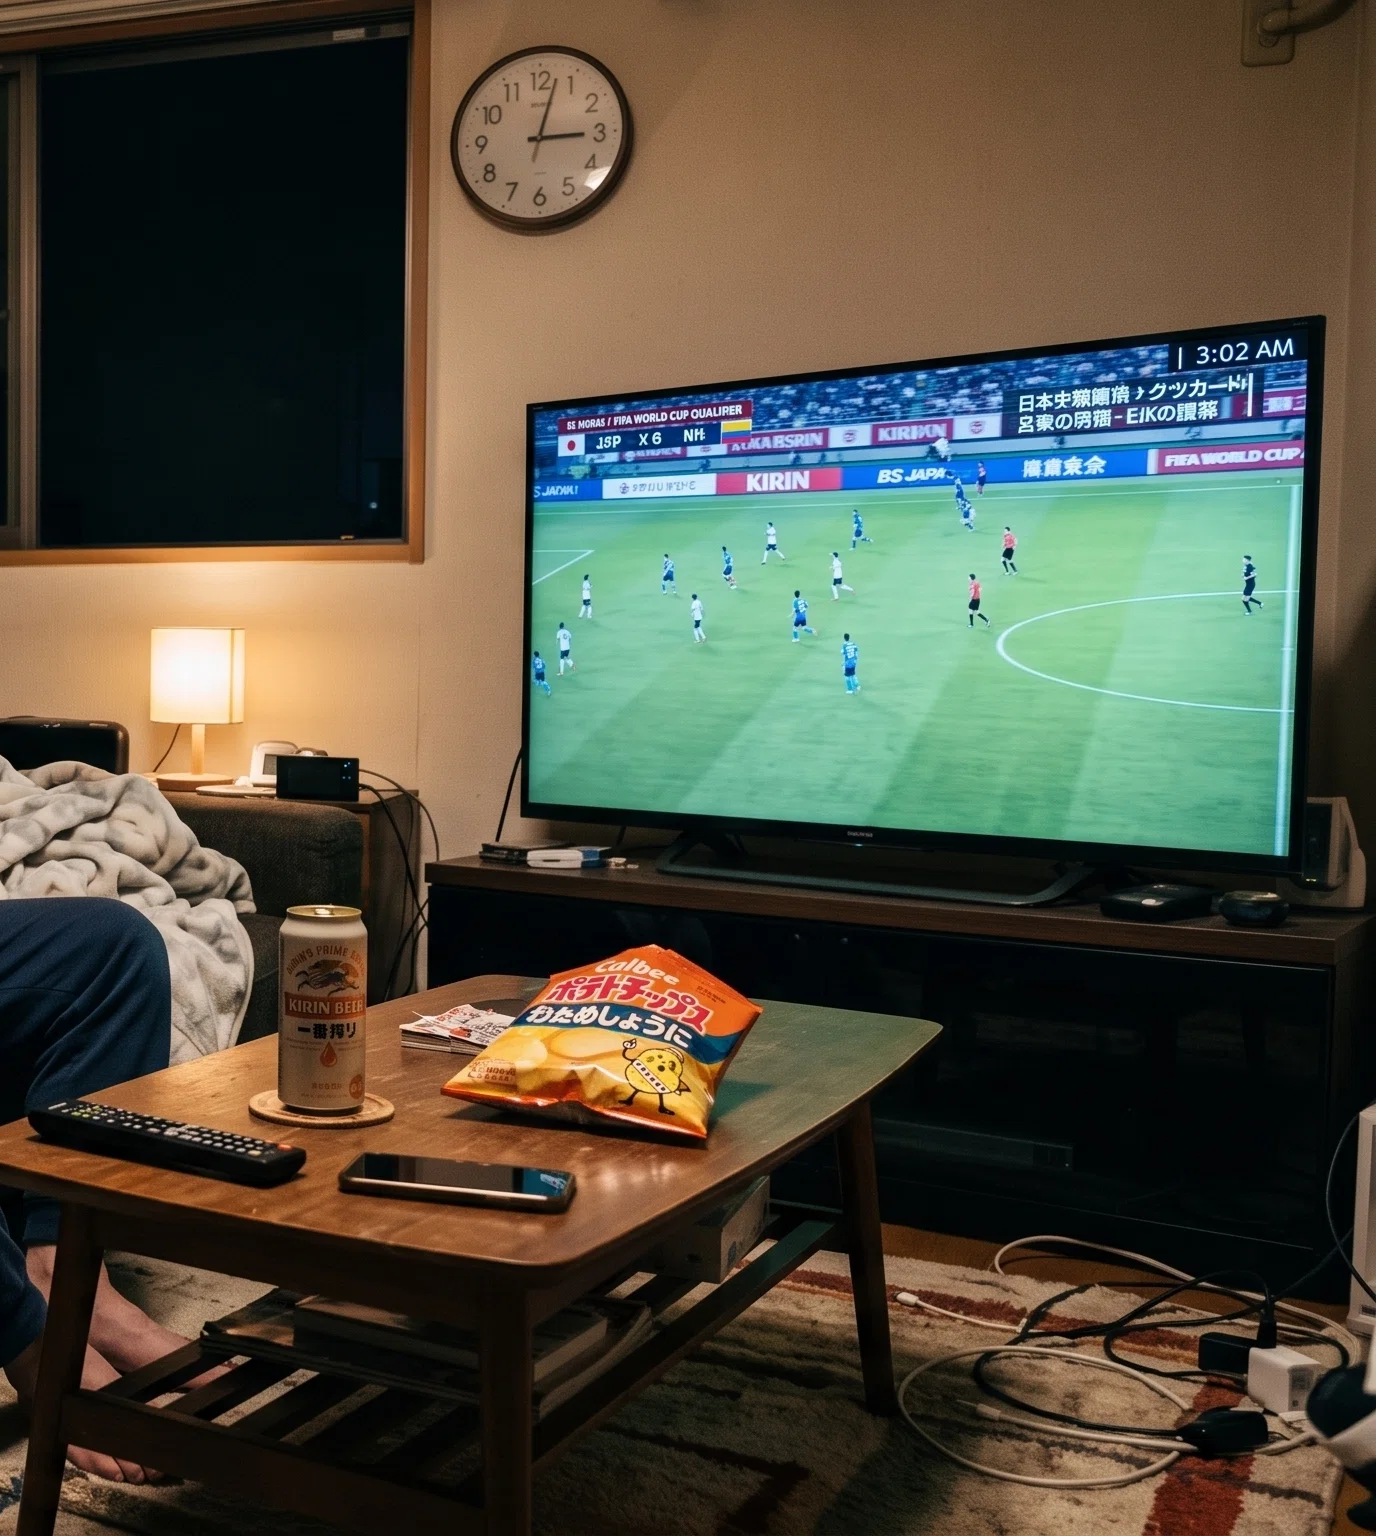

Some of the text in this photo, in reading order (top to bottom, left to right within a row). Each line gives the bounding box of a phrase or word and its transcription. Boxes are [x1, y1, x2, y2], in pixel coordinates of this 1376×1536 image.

[530, 70, 551, 91] 12
[567, 75, 574, 95] 1
[504, 82, 520, 103] 11
[585, 92, 599, 114] 2
[483, 104, 502, 125] 10
[593, 122, 607, 143] 3
[475, 135, 488, 155] 9
[584, 153, 598, 170] 4
[483, 163, 497, 183] 8
[505, 181, 519, 202] 7
[562, 176, 575, 196] 5
[532, 186, 547, 207] 6
[1196, 338, 1294, 365] 3:02 AM
[633, 411, 668, 424] WORLD
[669, 409, 690, 421] CUP
[1263, 447, 1301, 462] CUP
[745, 469, 811, 492] KIRIN
[876, 468, 904, 484] BS
[316, 944, 349, 957] PRIME
[289, 998, 364, 1015] KIRIN BEER
[544, 974, 713, 1036] ポテトチップス
